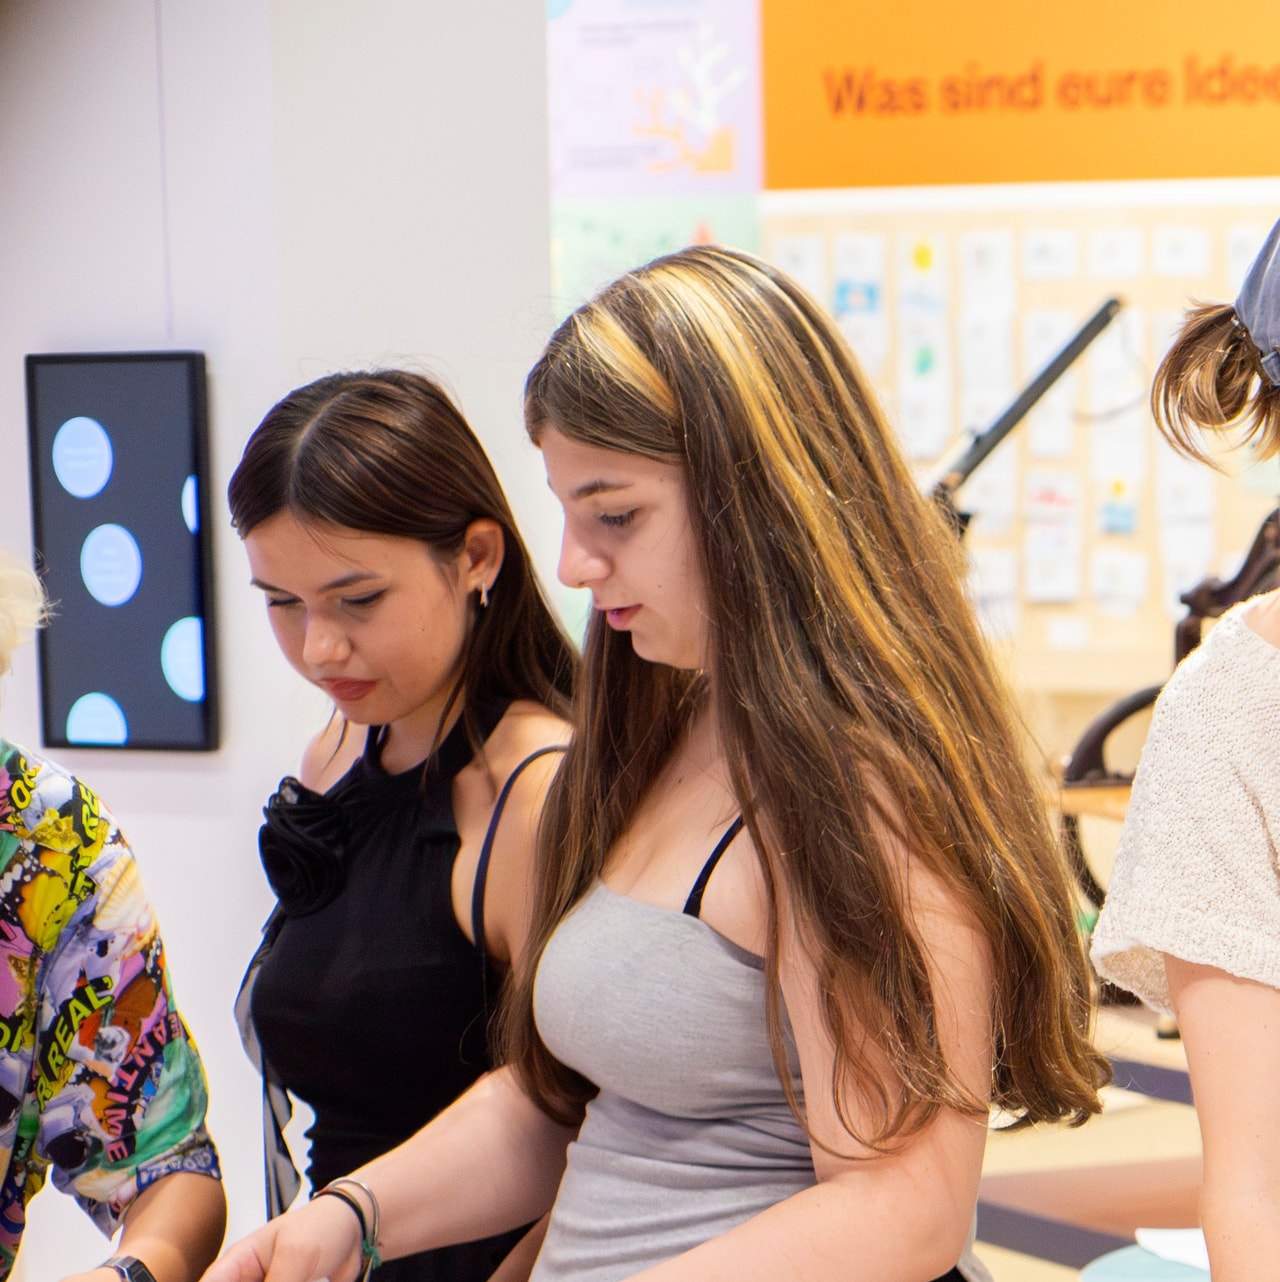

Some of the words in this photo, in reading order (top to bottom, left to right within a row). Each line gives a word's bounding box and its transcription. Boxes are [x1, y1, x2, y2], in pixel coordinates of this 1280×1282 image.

[822, 64, 928, 118] Was
[939, 57, 1046, 115] sind
[1055, 66, 1172, 110] eure
